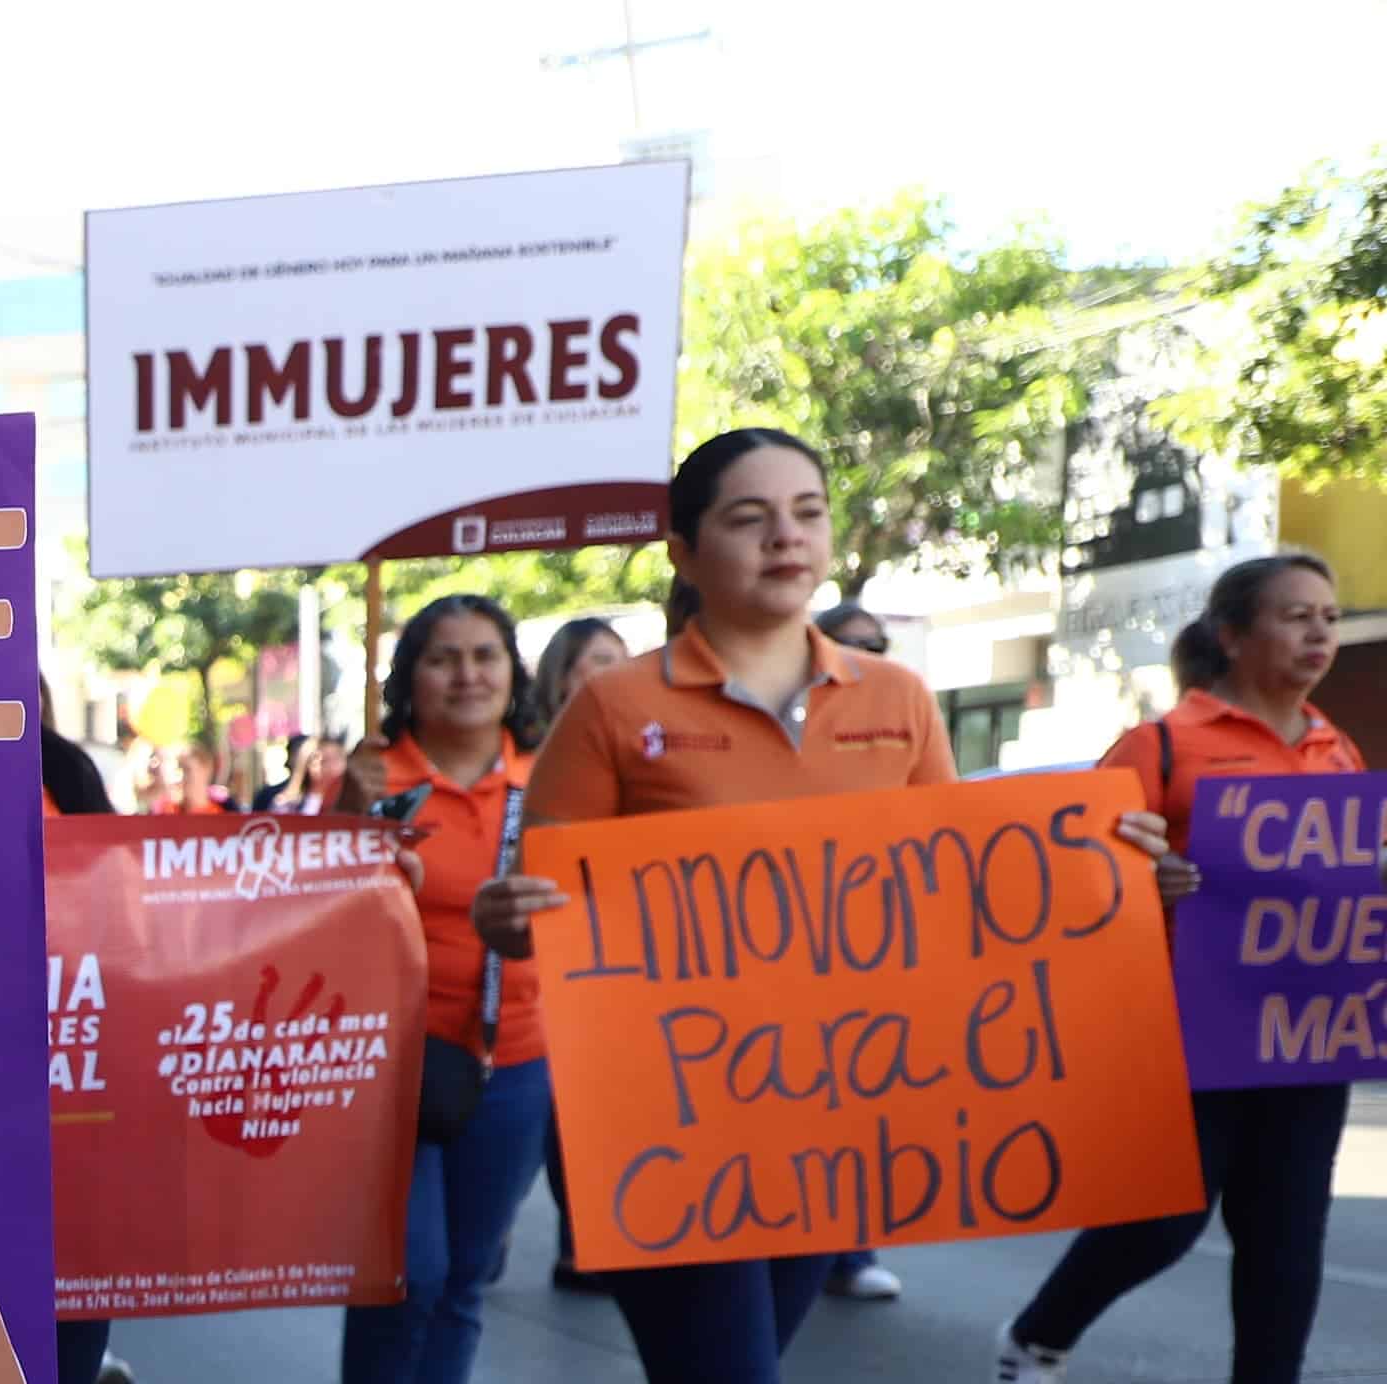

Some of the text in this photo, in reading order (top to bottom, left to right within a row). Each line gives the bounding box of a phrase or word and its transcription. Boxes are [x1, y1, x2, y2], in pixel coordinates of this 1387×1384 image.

[132, 311, 641, 433] IMMUJERES
[181, 1001, 235, 1044] 25
[233, 1018, 266, 1042] de
[274, 1014, 331, 1038] cada
[338, 1012, 389, 1032] mes
[964, 959, 1065, 1091] el
[1257, 979, 1387, 1064] MÁ
[171, 1062, 376, 1096] Contra la violencia
[189, 1087, 355, 1118] hacia Mujeres y
[241, 1117, 300, 1140] Niñas
